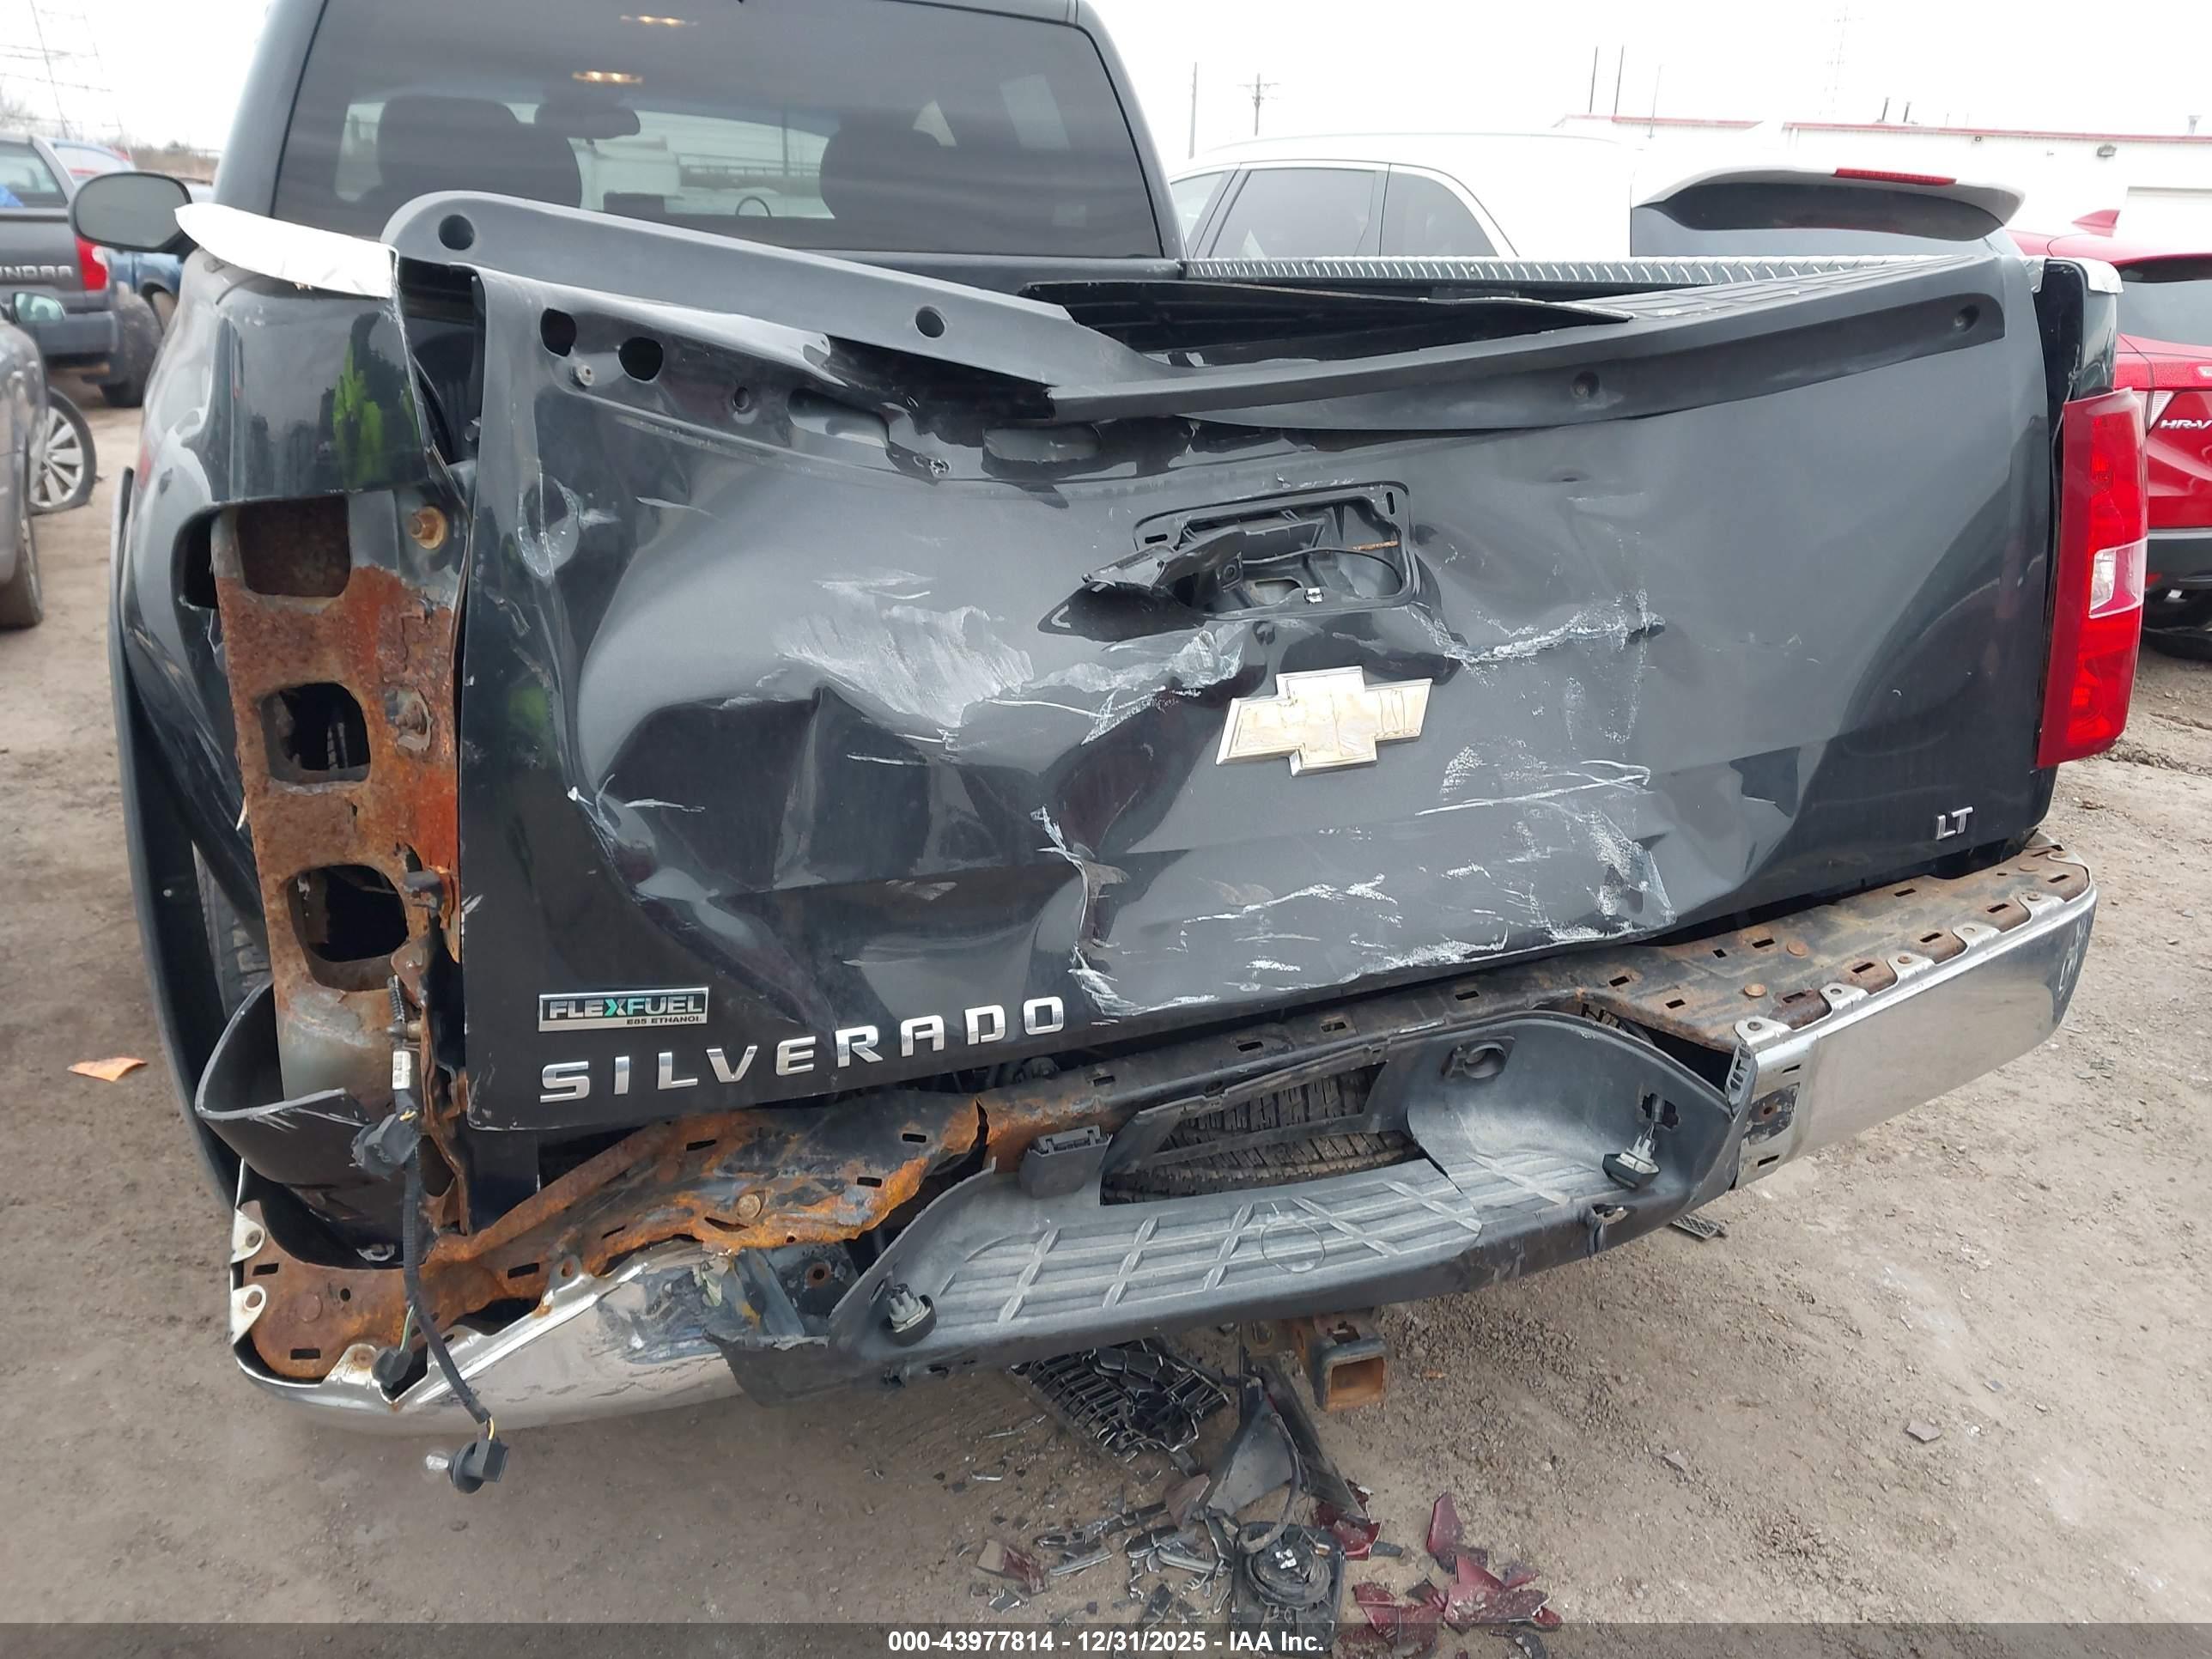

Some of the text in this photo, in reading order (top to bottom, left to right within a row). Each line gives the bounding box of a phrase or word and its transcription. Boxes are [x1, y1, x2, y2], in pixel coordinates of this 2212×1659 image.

[2160, 419, 2212, 429] HR-V
[1936, 805, 1973, 841] LT
[549, 995, 703, 1019] FLEXFUEL
[626, 1015, 702, 1025] E85 ETHANOL
[539, 995, 1065, 1103] SILVERADO
